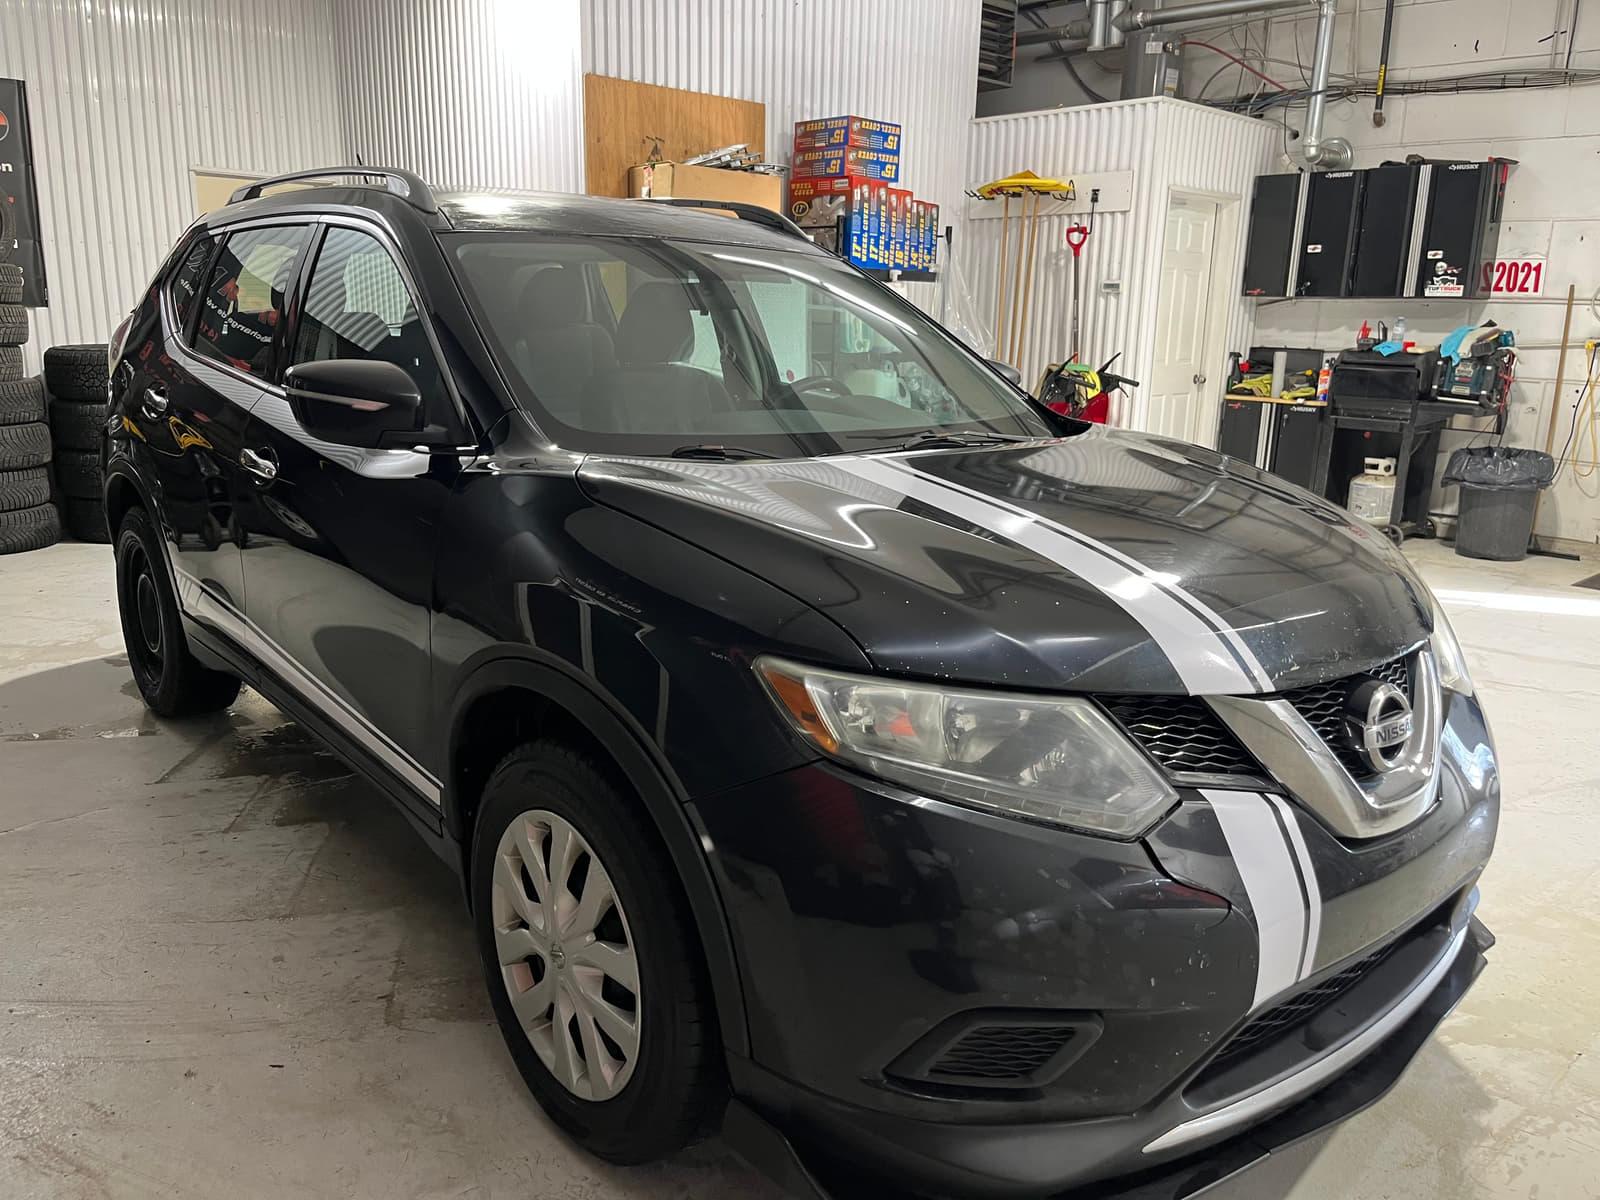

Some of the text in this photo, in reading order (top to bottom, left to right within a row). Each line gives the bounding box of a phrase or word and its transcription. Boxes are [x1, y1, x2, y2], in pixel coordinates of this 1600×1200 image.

[806, 119, 848, 132] WHEEL COVER
[861, 121, 900, 136] WHEEL COVER
[804, 149, 843, 161] WHEEL COVER
[857, 150, 898, 164] WHEEL COVER
[903, 212, 912, 268] WHEEL COVER
[888, 239, 896, 267] WHEEL
[1493, 262, 1542, 293] 2021
